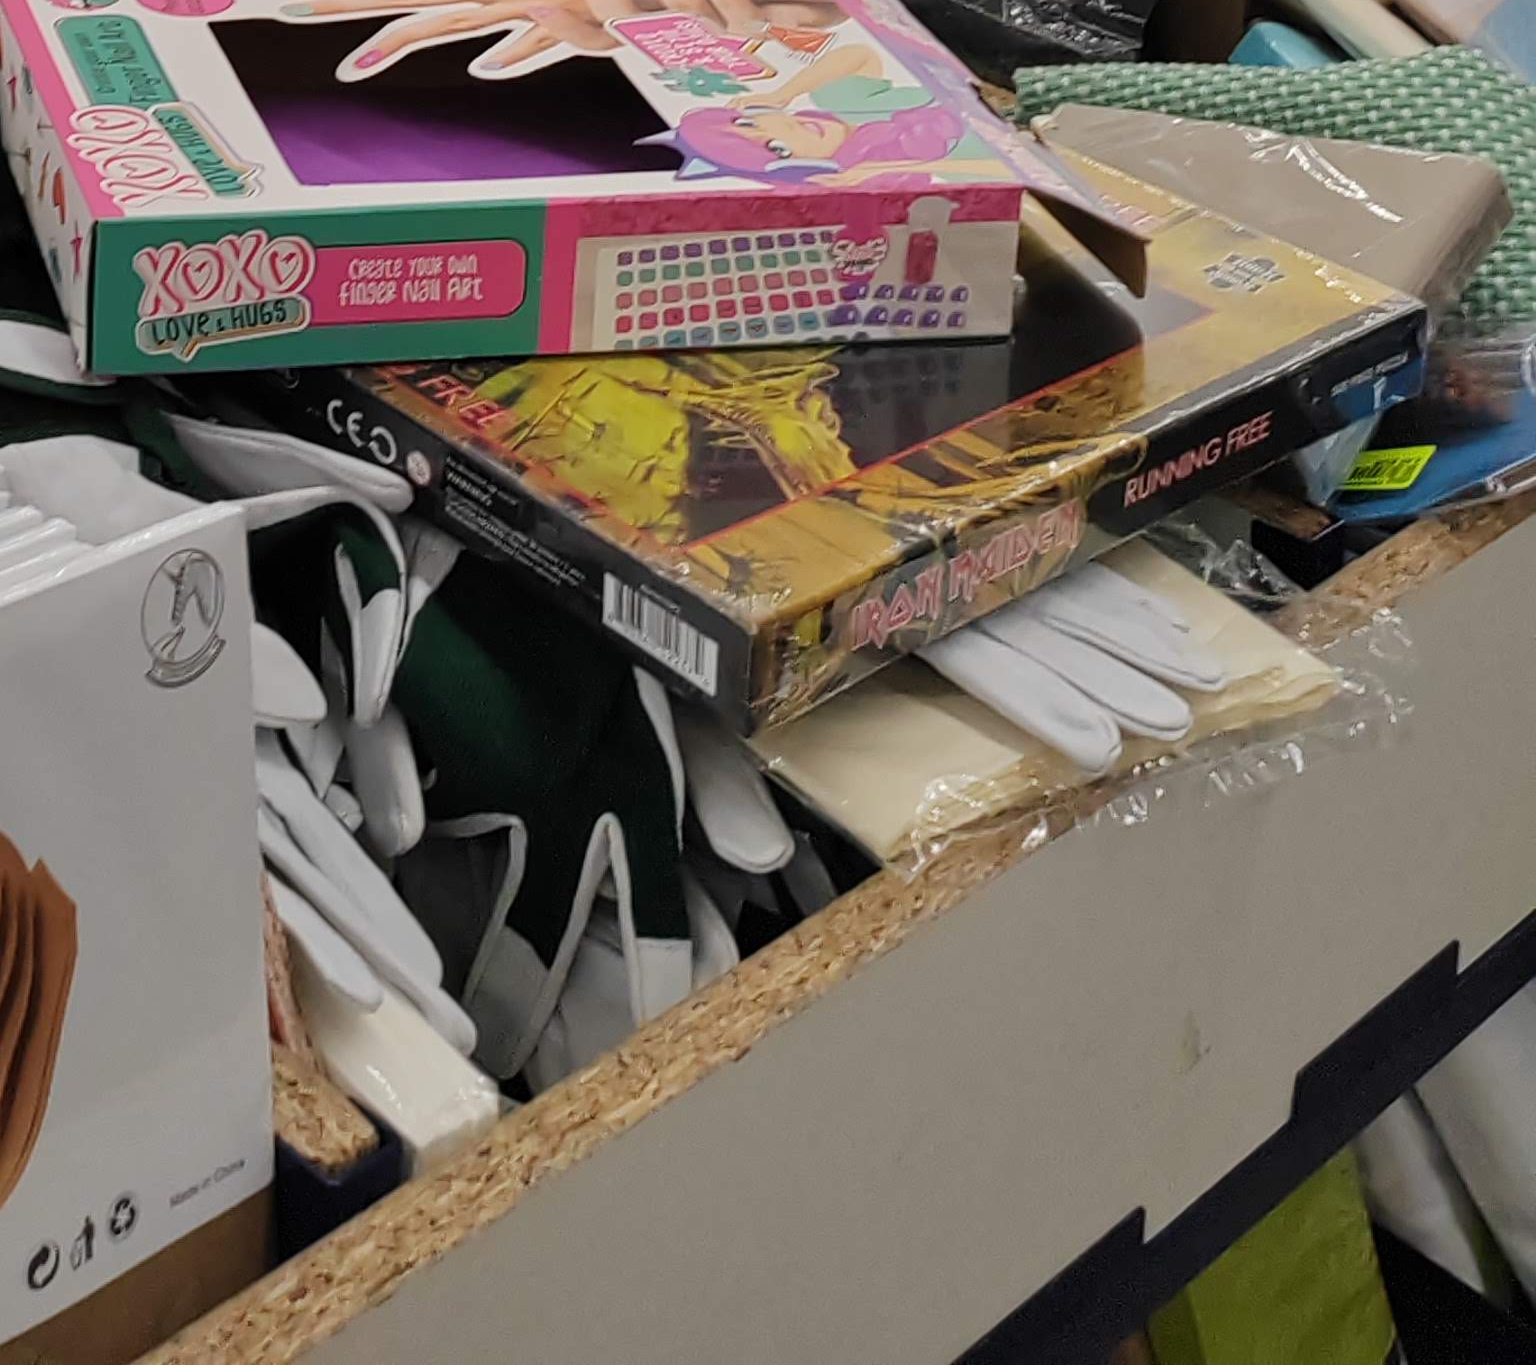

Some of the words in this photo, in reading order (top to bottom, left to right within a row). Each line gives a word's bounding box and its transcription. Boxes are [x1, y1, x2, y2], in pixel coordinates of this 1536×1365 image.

[136, 231, 314, 315] XOXO
[231, 300, 287, 330] HUGS
[1123, 435, 1222, 509] RUNNING
[1224, 411, 1273, 456] FREE
[850, 563, 942, 652] IRON
[947, 497, 1082, 603] MAIDEN
